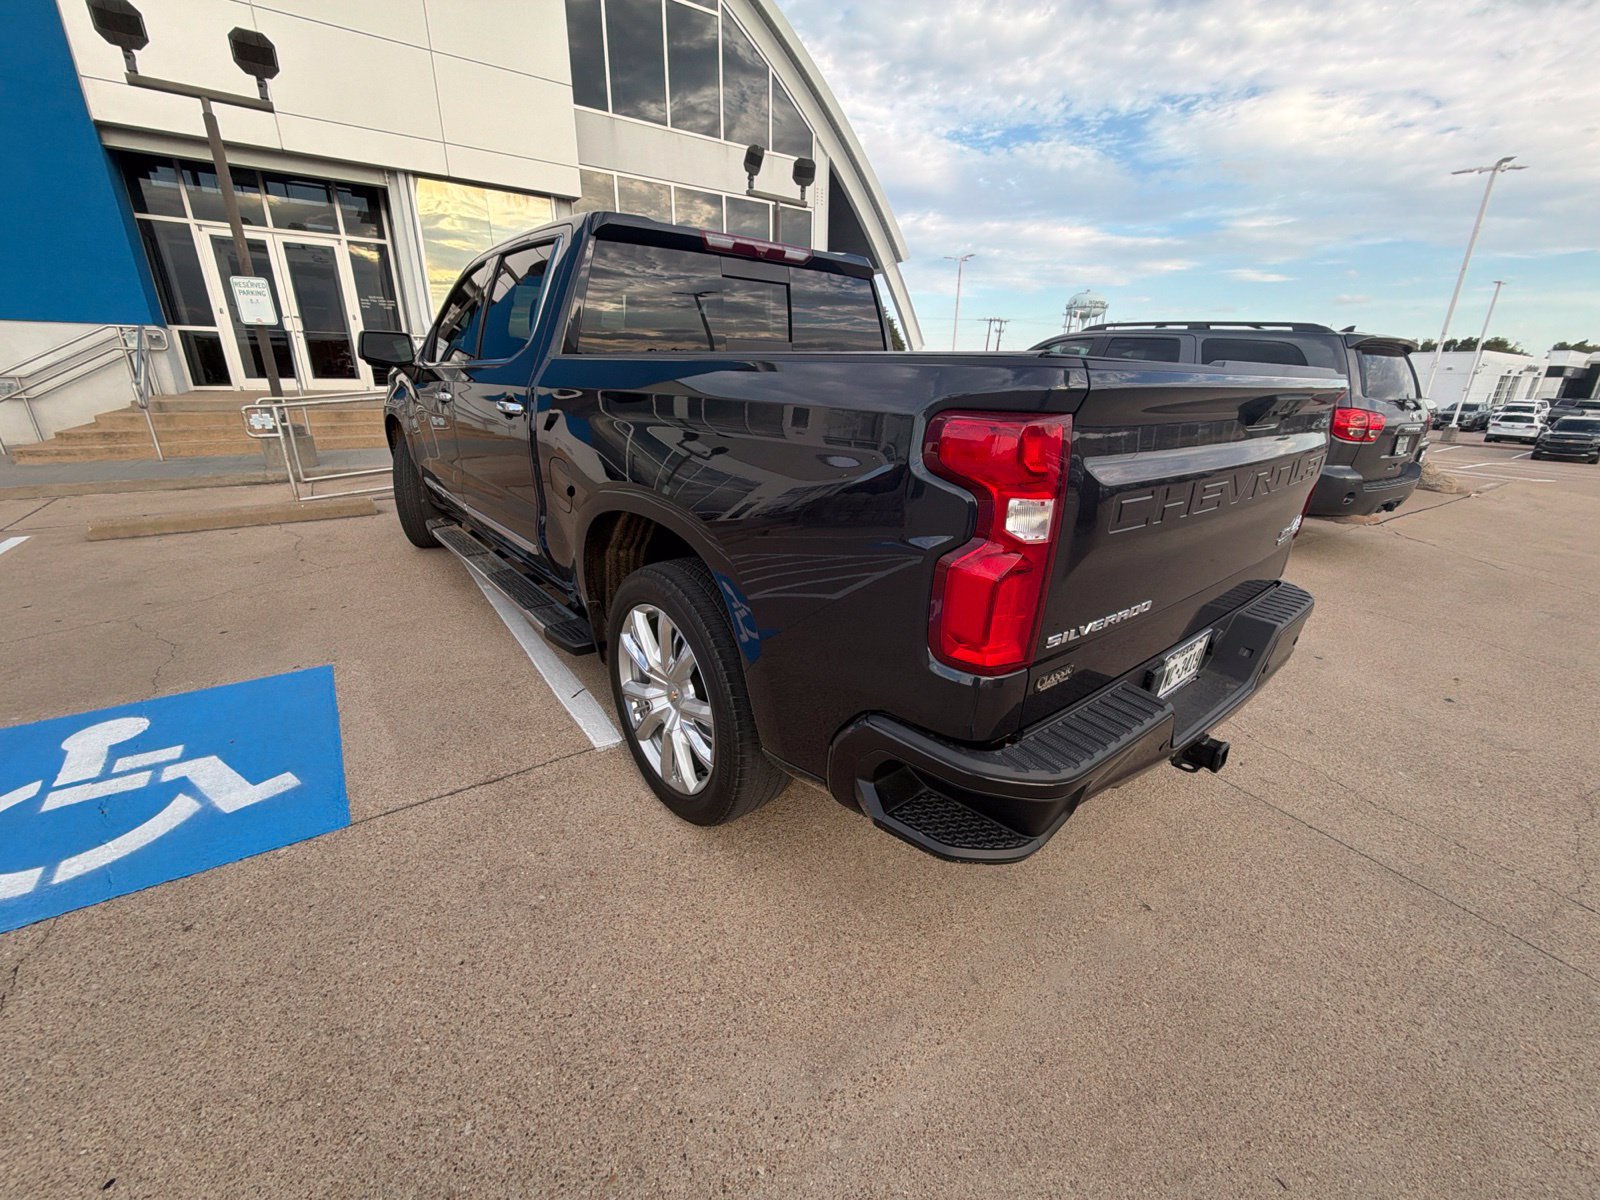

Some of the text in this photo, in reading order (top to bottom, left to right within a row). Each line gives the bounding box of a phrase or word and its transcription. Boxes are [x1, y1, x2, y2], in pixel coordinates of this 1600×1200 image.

[233, 281, 266, 289] RESERVED
[238, 289, 267, 297] PARKING
[1108, 455, 1325, 535] CHEVROLET
[1046, 600, 1152, 649] SILVERADO
